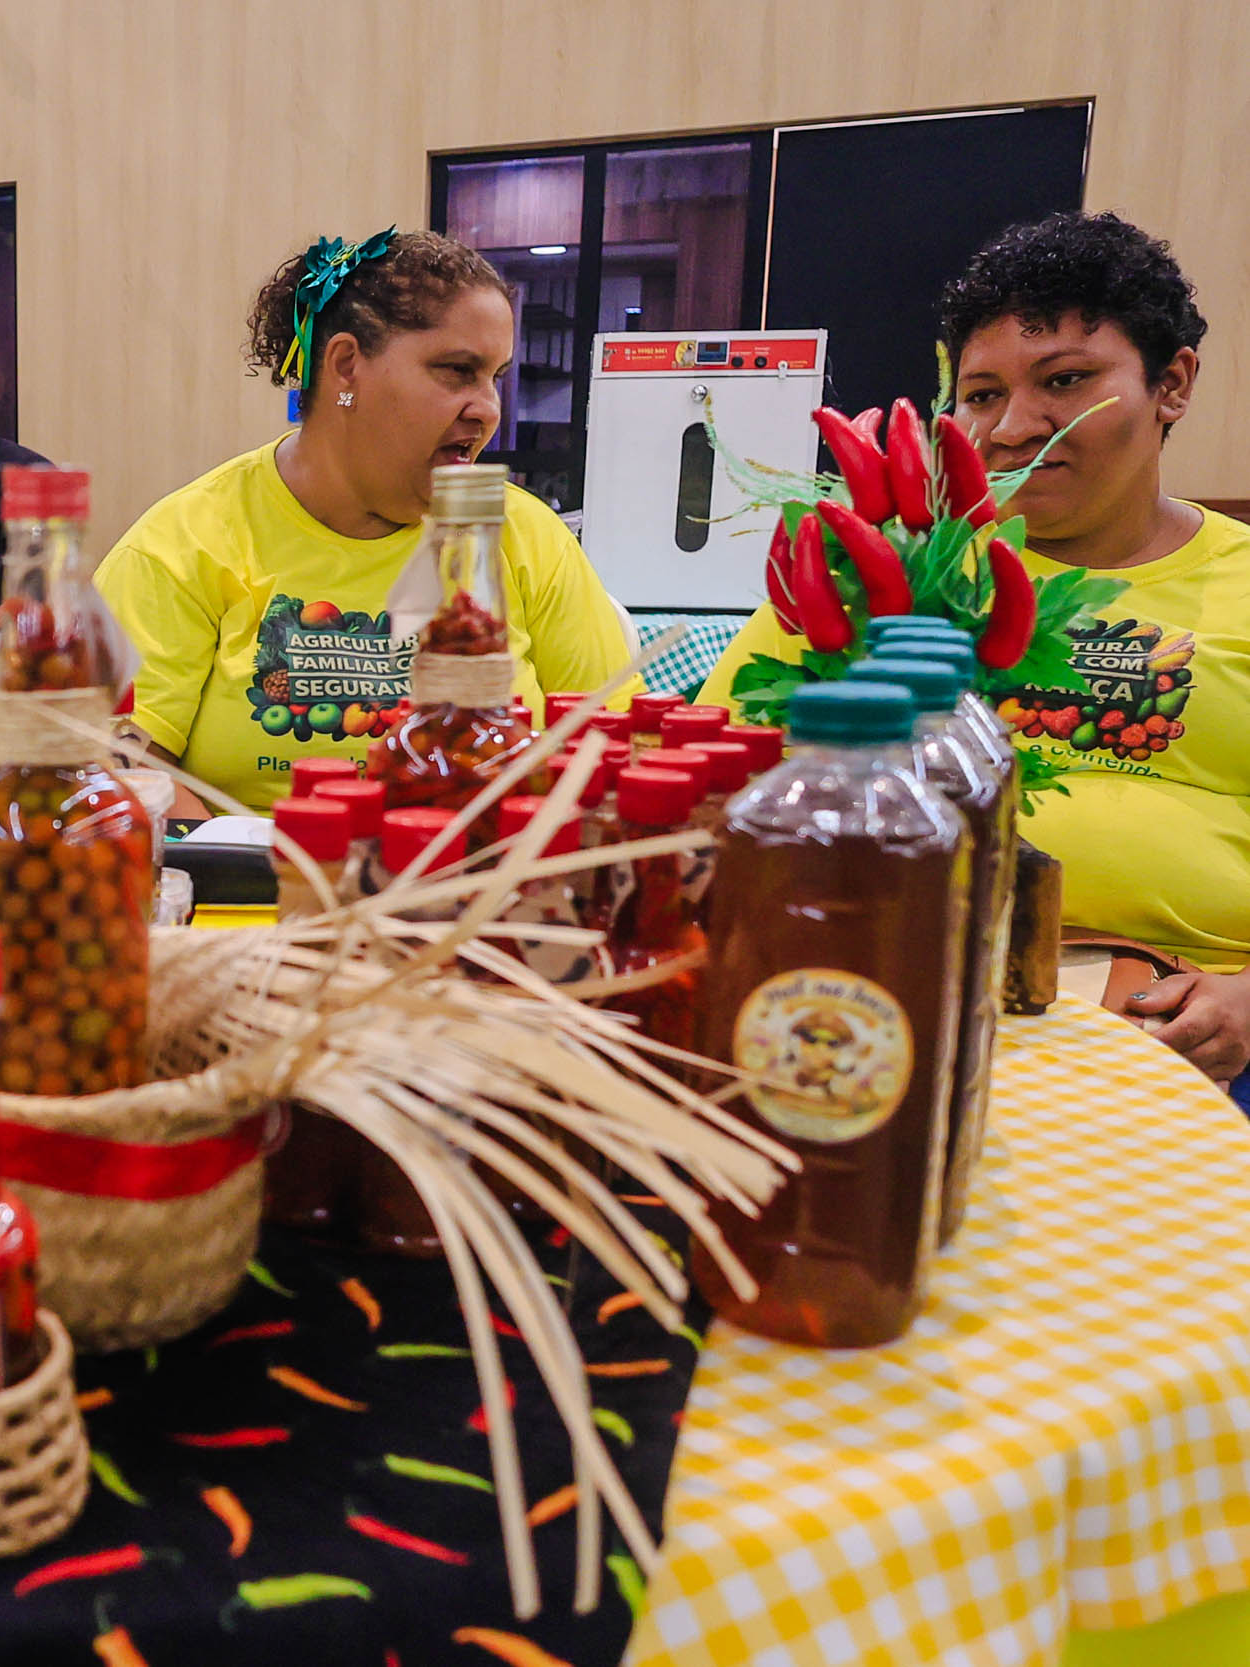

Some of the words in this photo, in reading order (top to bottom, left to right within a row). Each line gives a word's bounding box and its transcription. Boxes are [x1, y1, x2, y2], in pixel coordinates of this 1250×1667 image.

[290, 633, 419, 653] AGRICULTUR
[292, 655, 391, 673] FAMILIAR
[1084, 656, 1143, 671] COM
[295, 679, 412, 697] SEGURAN
